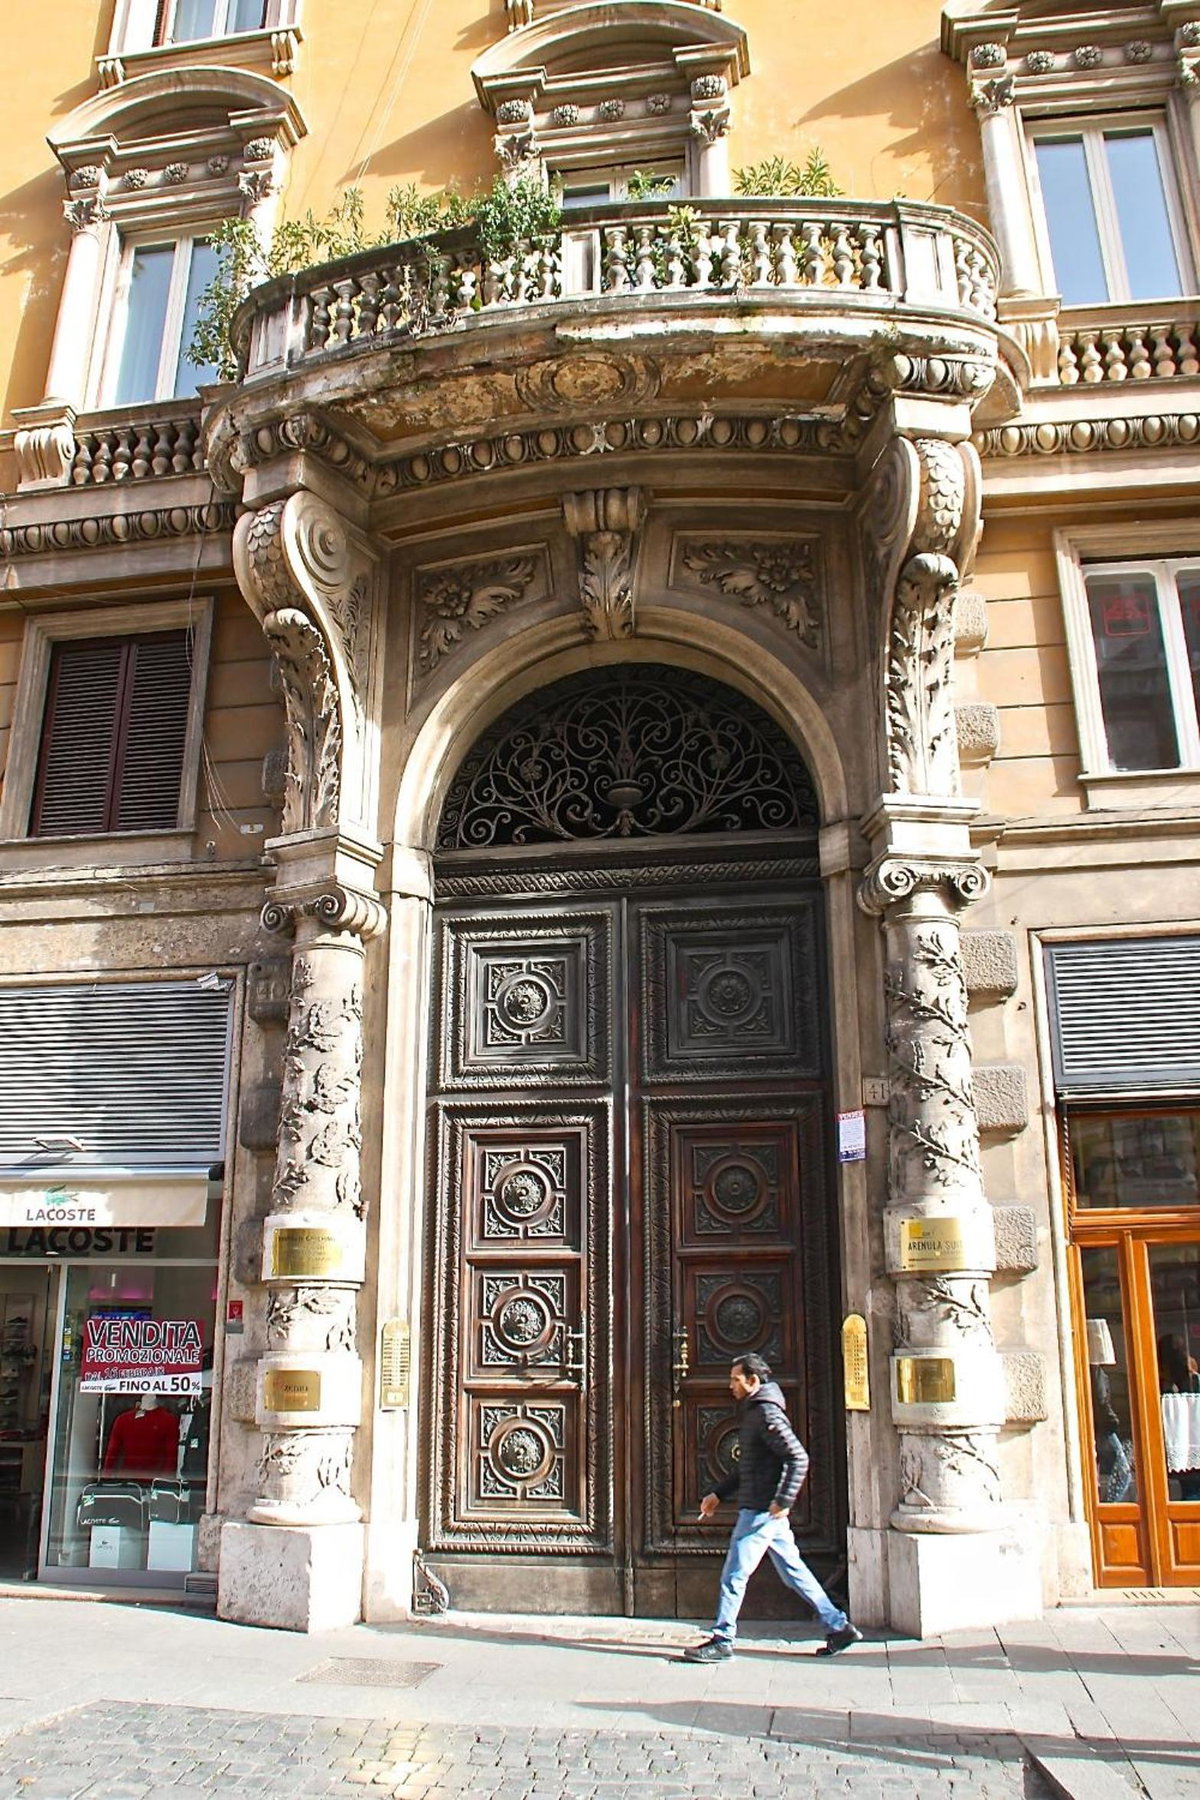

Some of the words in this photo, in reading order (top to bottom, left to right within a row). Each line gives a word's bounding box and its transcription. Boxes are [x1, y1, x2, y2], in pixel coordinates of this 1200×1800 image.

[869, 1083, 886, 1100] 41
[26, 1208, 96, 1221] LACOSTE
[7, 1226, 156, 1252] LACOSTE
[908, 1240, 942, 1251] ARENULA
[87, 1320, 202, 1349] VENDITA
[86, 1347, 200, 1364] PROMOZIONALE
[119, 1380, 151, 1392] FINO
[152, 1380, 169, 1392] AL
[170, 1376, 190, 1392] 50
